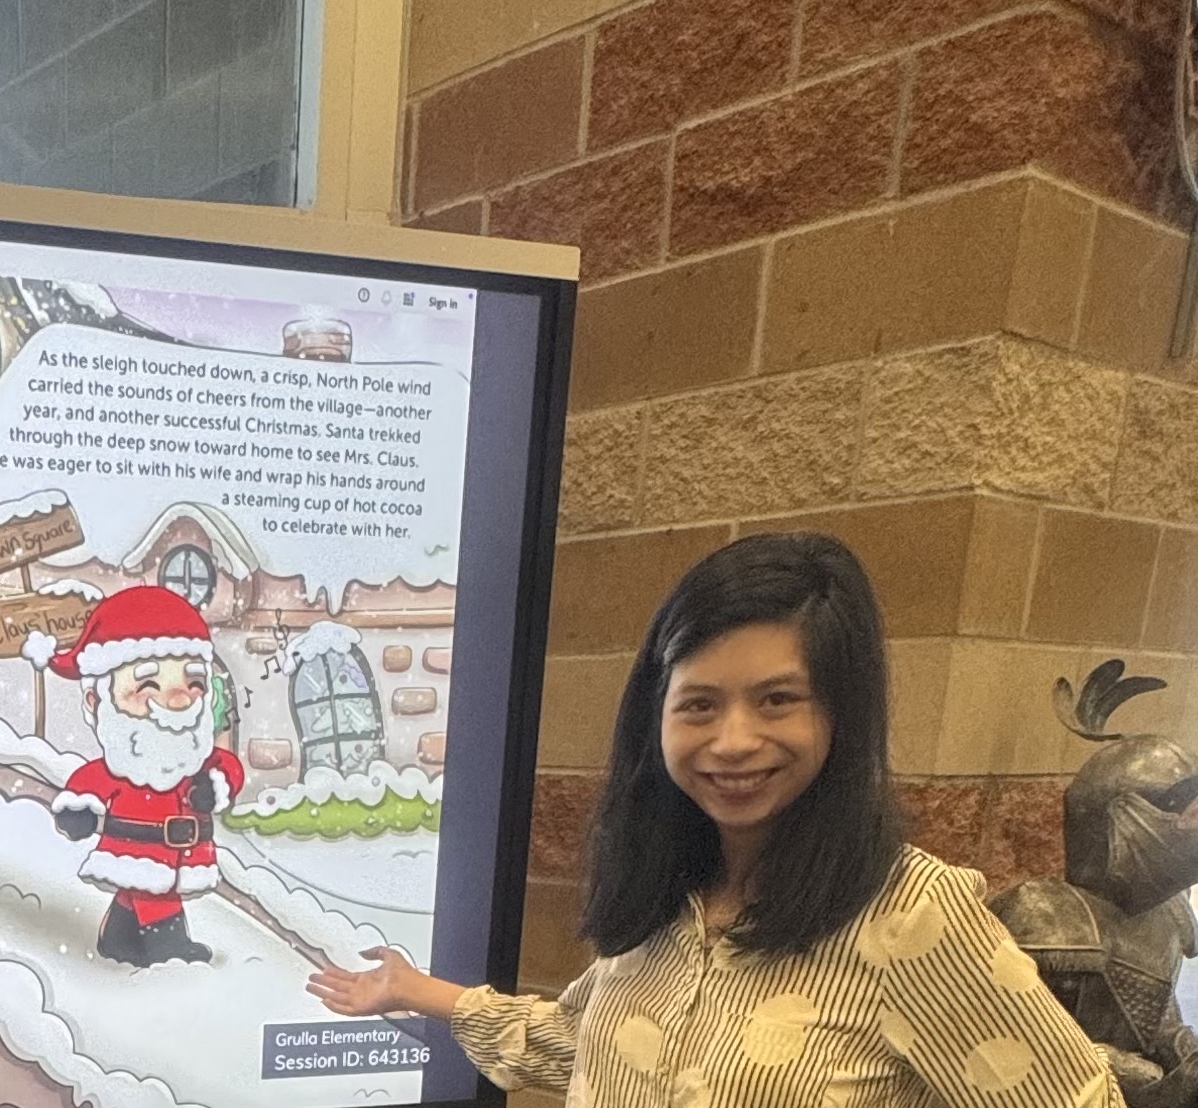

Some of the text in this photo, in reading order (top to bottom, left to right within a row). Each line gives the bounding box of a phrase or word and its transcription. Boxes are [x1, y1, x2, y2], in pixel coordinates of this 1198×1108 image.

[428, 296, 458, 310] Sign in
[39, 350, 431, 396] As the sleigh touched down, a crisp, North Pole wind
[28, 378, 83, 395] carried
[88, 381, 113, 397] the
[118, 383, 172, 401] sounds
[177, 388, 193, 403] of
[196, 391, 246, 407] cheers
[251, 393, 285, 409] from
[290, 396, 313, 412] the
[23, 403, 61, 421] year,
[65, 406, 94, 422] and
[99, 408, 159, 425] another
[164, 412, 241, 432] successful
[325, 423, 364, 441] Santa
[369, 427, 421, 444] trekked
[9, 428, 419, 468] through the deep snow toward home to see Mrs. Claus.
[13, 456, 43, 470] was
[48, 459, 91, 475] eager
[96, 460, 112, 474] to
[116, 460, 133, 475] sit
[138, 460, 171, 478] with
[175, 464, 196, 479] his
[200, 466, 231, 481] wife
[235, 468, 262, 483] and
[266, 472, 303, 488] wrap
[307, 472, 326, 487] his
[330, 474, 372, 490] hands
[376, 478, 425, 492] around
[222, 493, 422, 516] a steaming cup of hot cocoa
[23, 519, 73, 551] Square
[262, 518, 411, 539] to celebrate with her.
[275, 1030, 400, 1047] Grulla Elementary
[274, 1047, 430, 1071] Session ID: 643136
